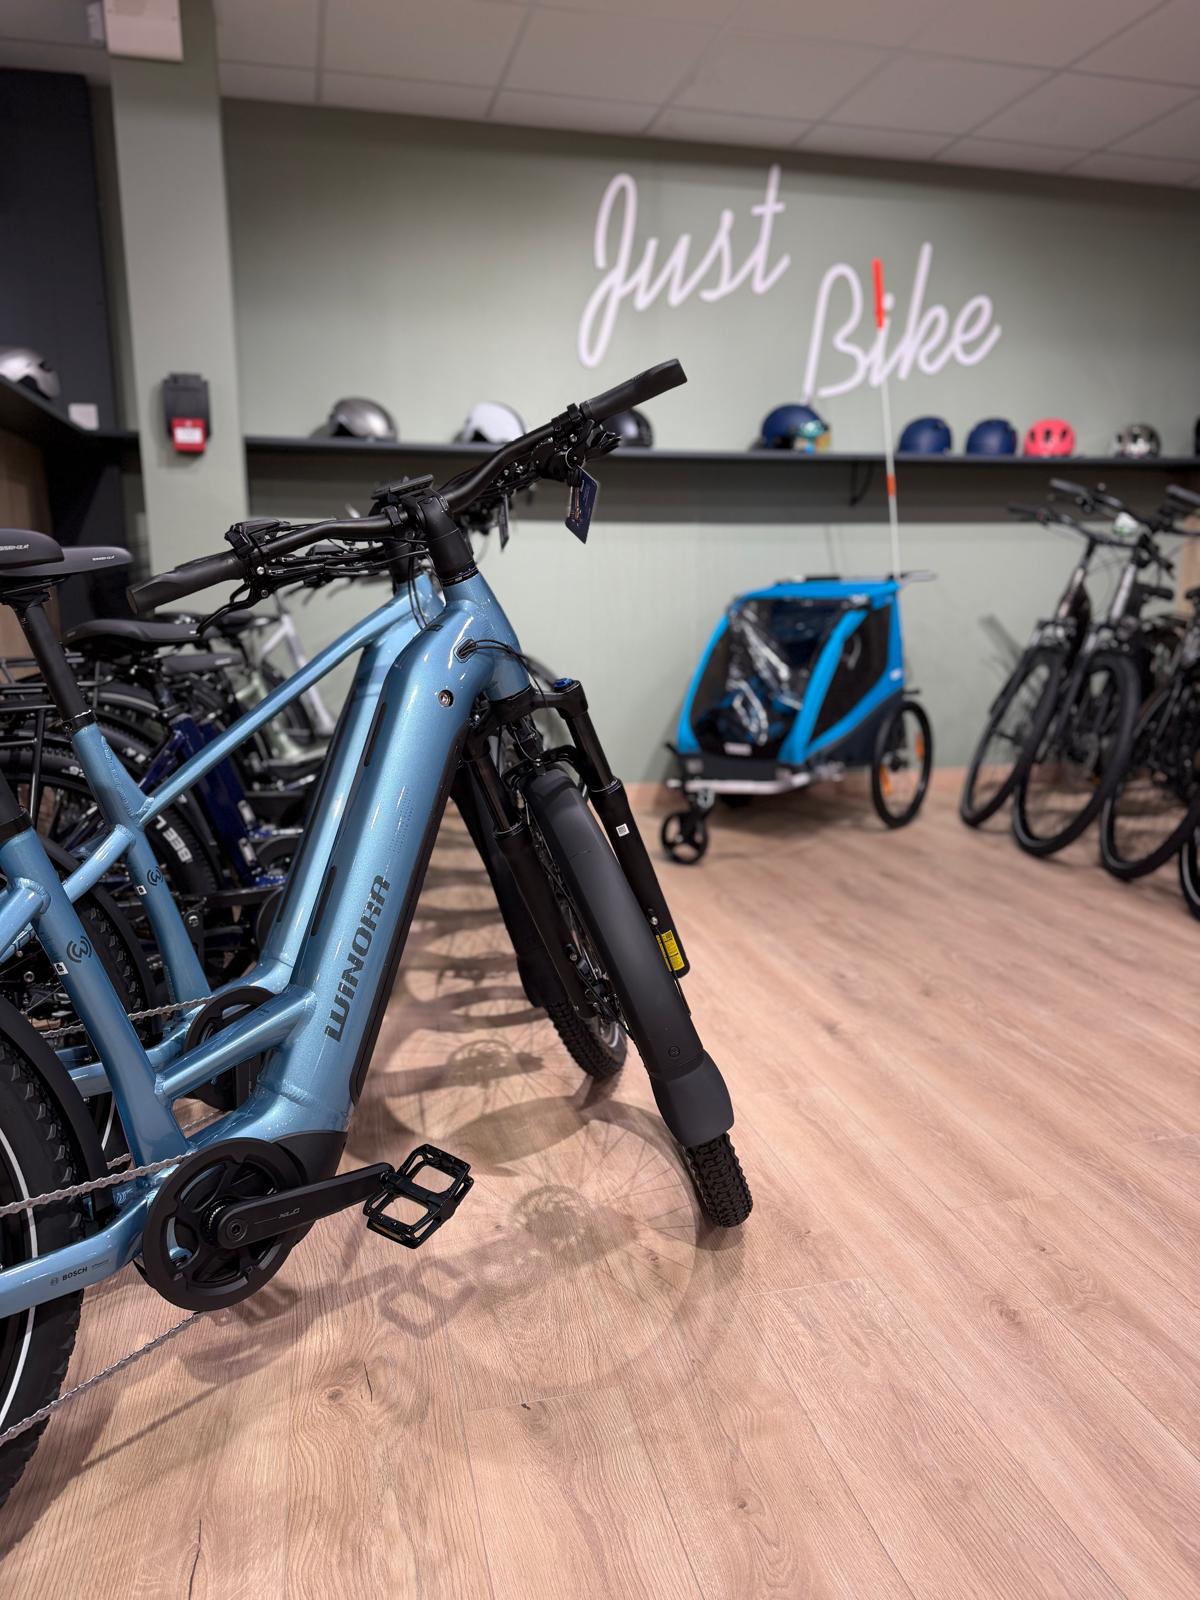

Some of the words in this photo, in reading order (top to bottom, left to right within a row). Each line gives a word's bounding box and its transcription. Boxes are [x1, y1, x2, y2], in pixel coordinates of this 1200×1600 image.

[578, 164, 790, 368] Just
[803, 242, 1001, 405] Bike
[325, 875, 391, 1042] WINORA
[62, 1266, 88, 1281] BOSCH
